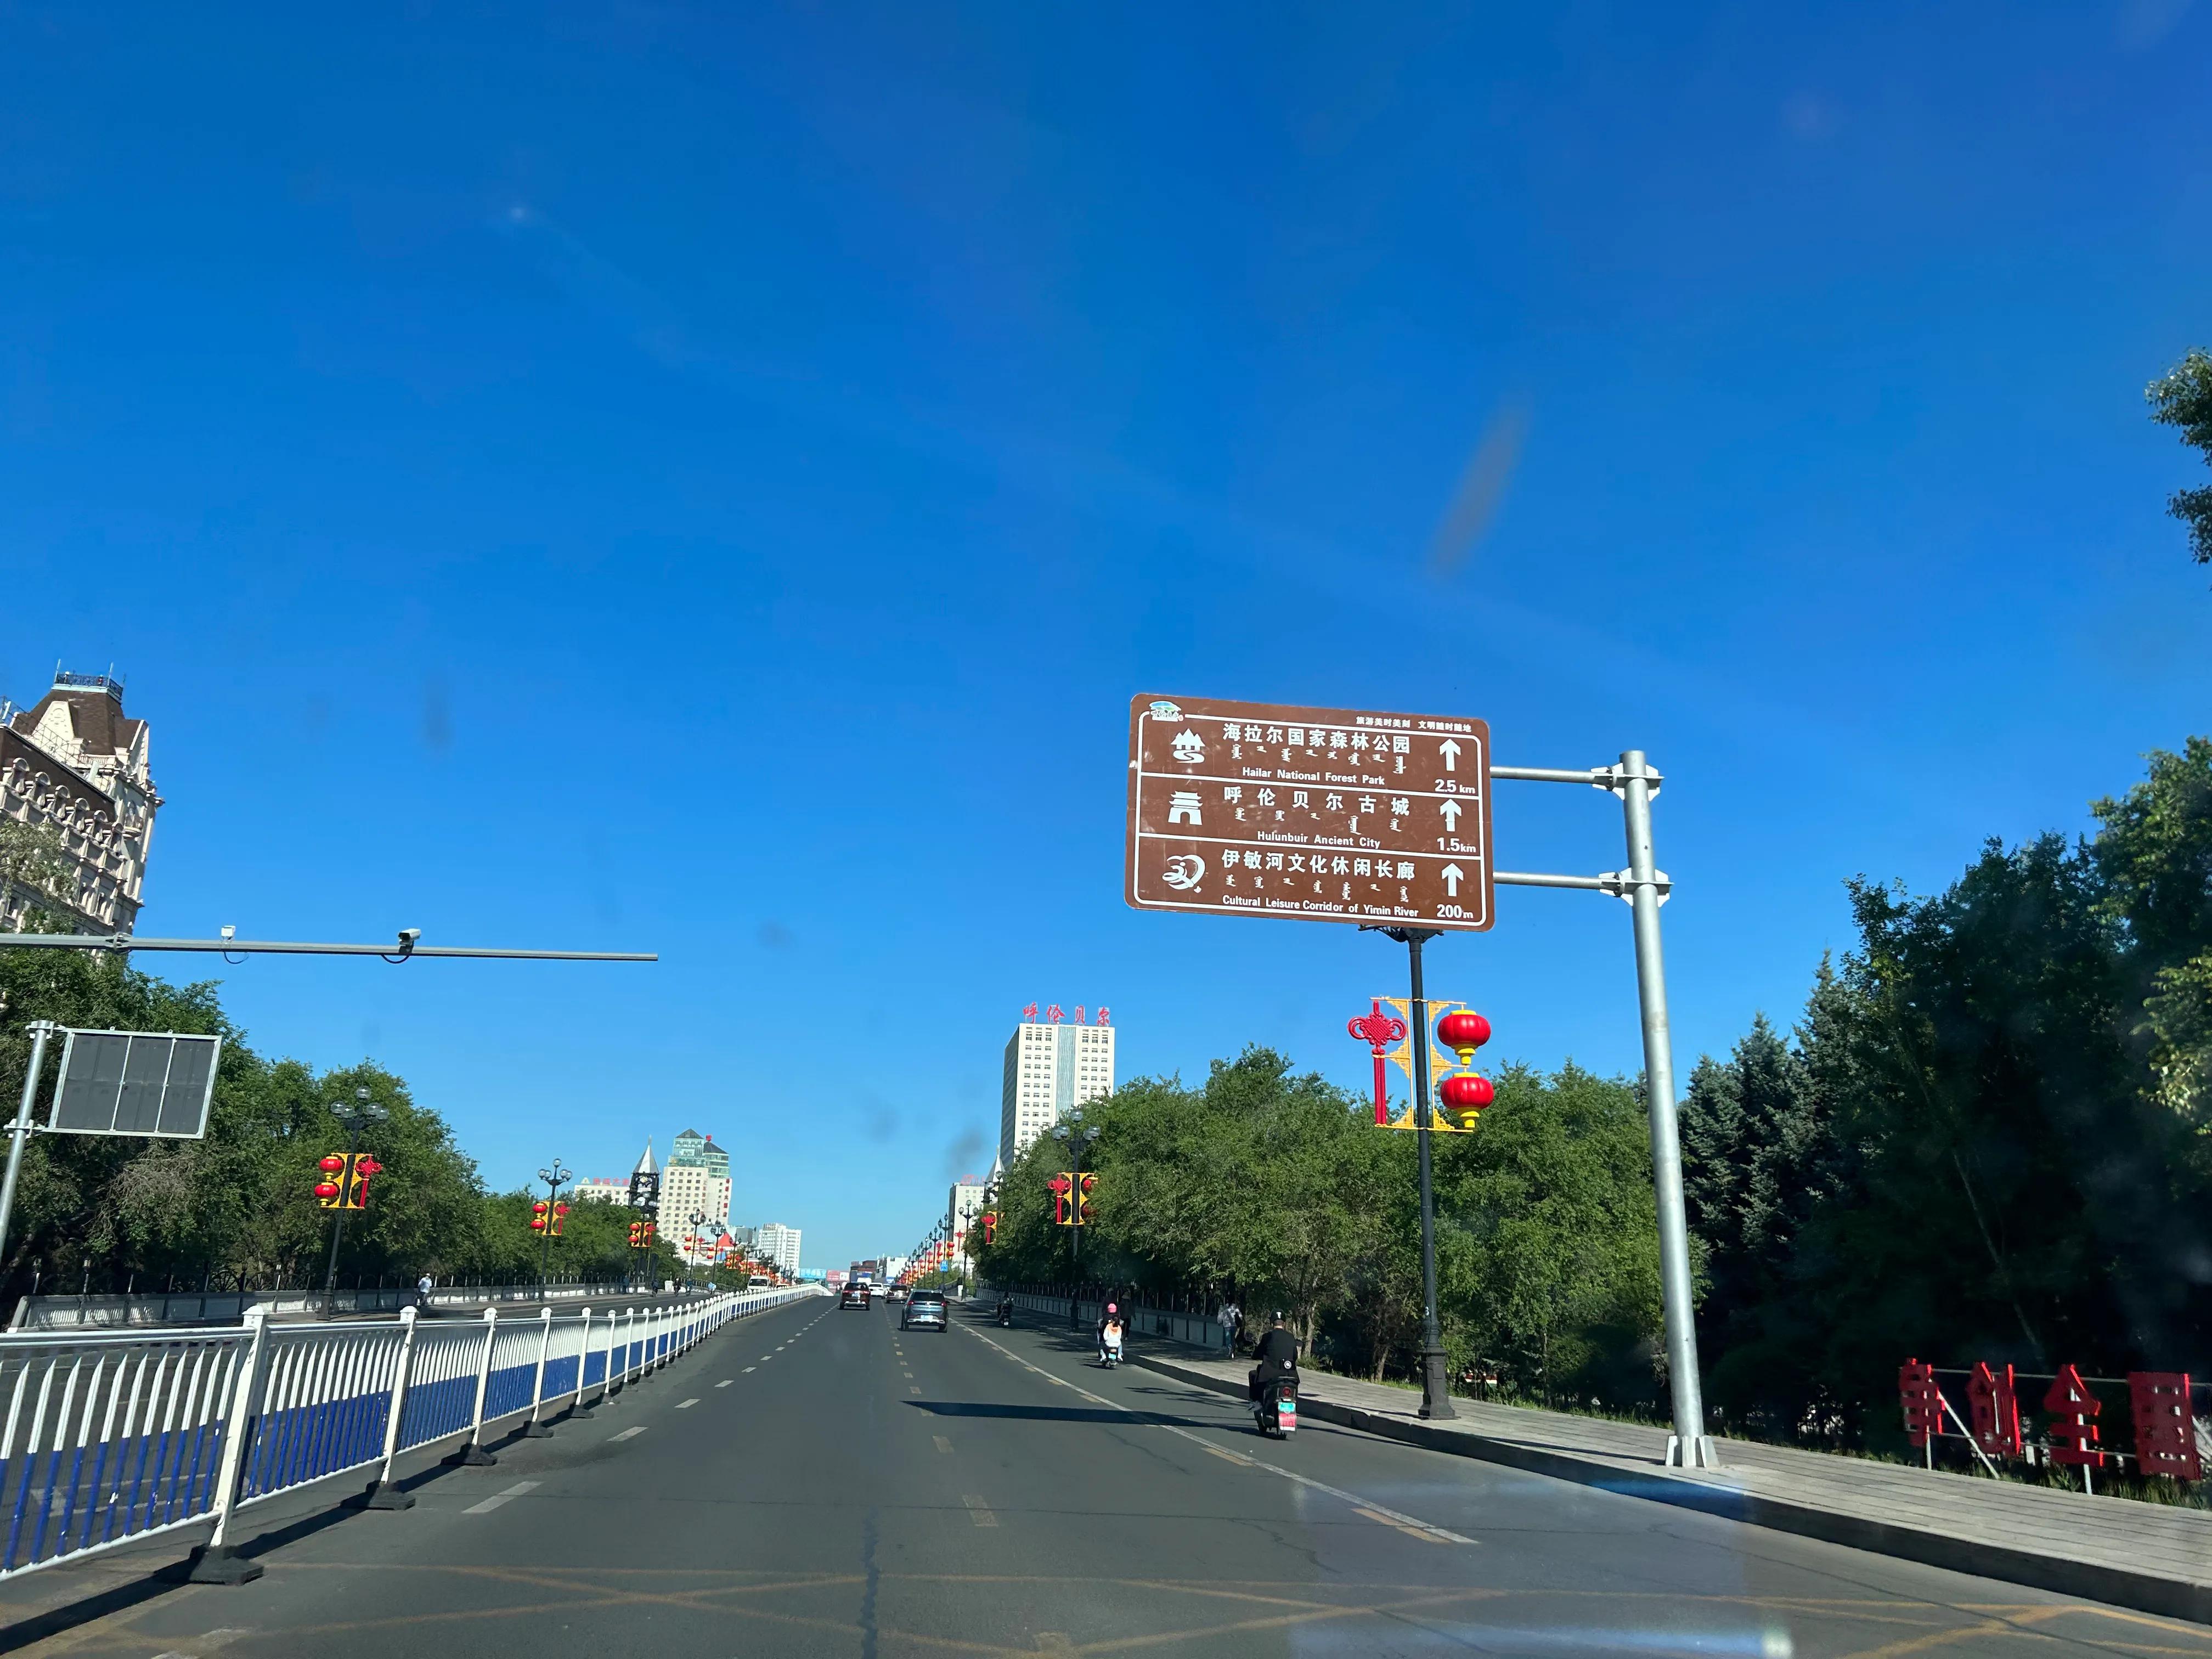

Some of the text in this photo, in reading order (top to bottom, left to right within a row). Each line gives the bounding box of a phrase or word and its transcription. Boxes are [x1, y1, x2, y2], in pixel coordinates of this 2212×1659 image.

[1418, 721, 1472, 732] 文明随时随地
[1223, 723, 1409, 754] 海拉尔国家森林公园
[1243, 768, 1385, 785] Hailar National Forest Park
[1435, 779, 1457, 792] 2.5
[1224, 787, 1410, 815] 呼伦贝尔古城
[1257, 831, 1380, 849] Hulunbuir Ancient City
[1222, 849, 1414, 880] 伊敏河文化休闲长廊
[1222, 895, 1419, 917] Cultural Leisure Corridor of Yimin River
